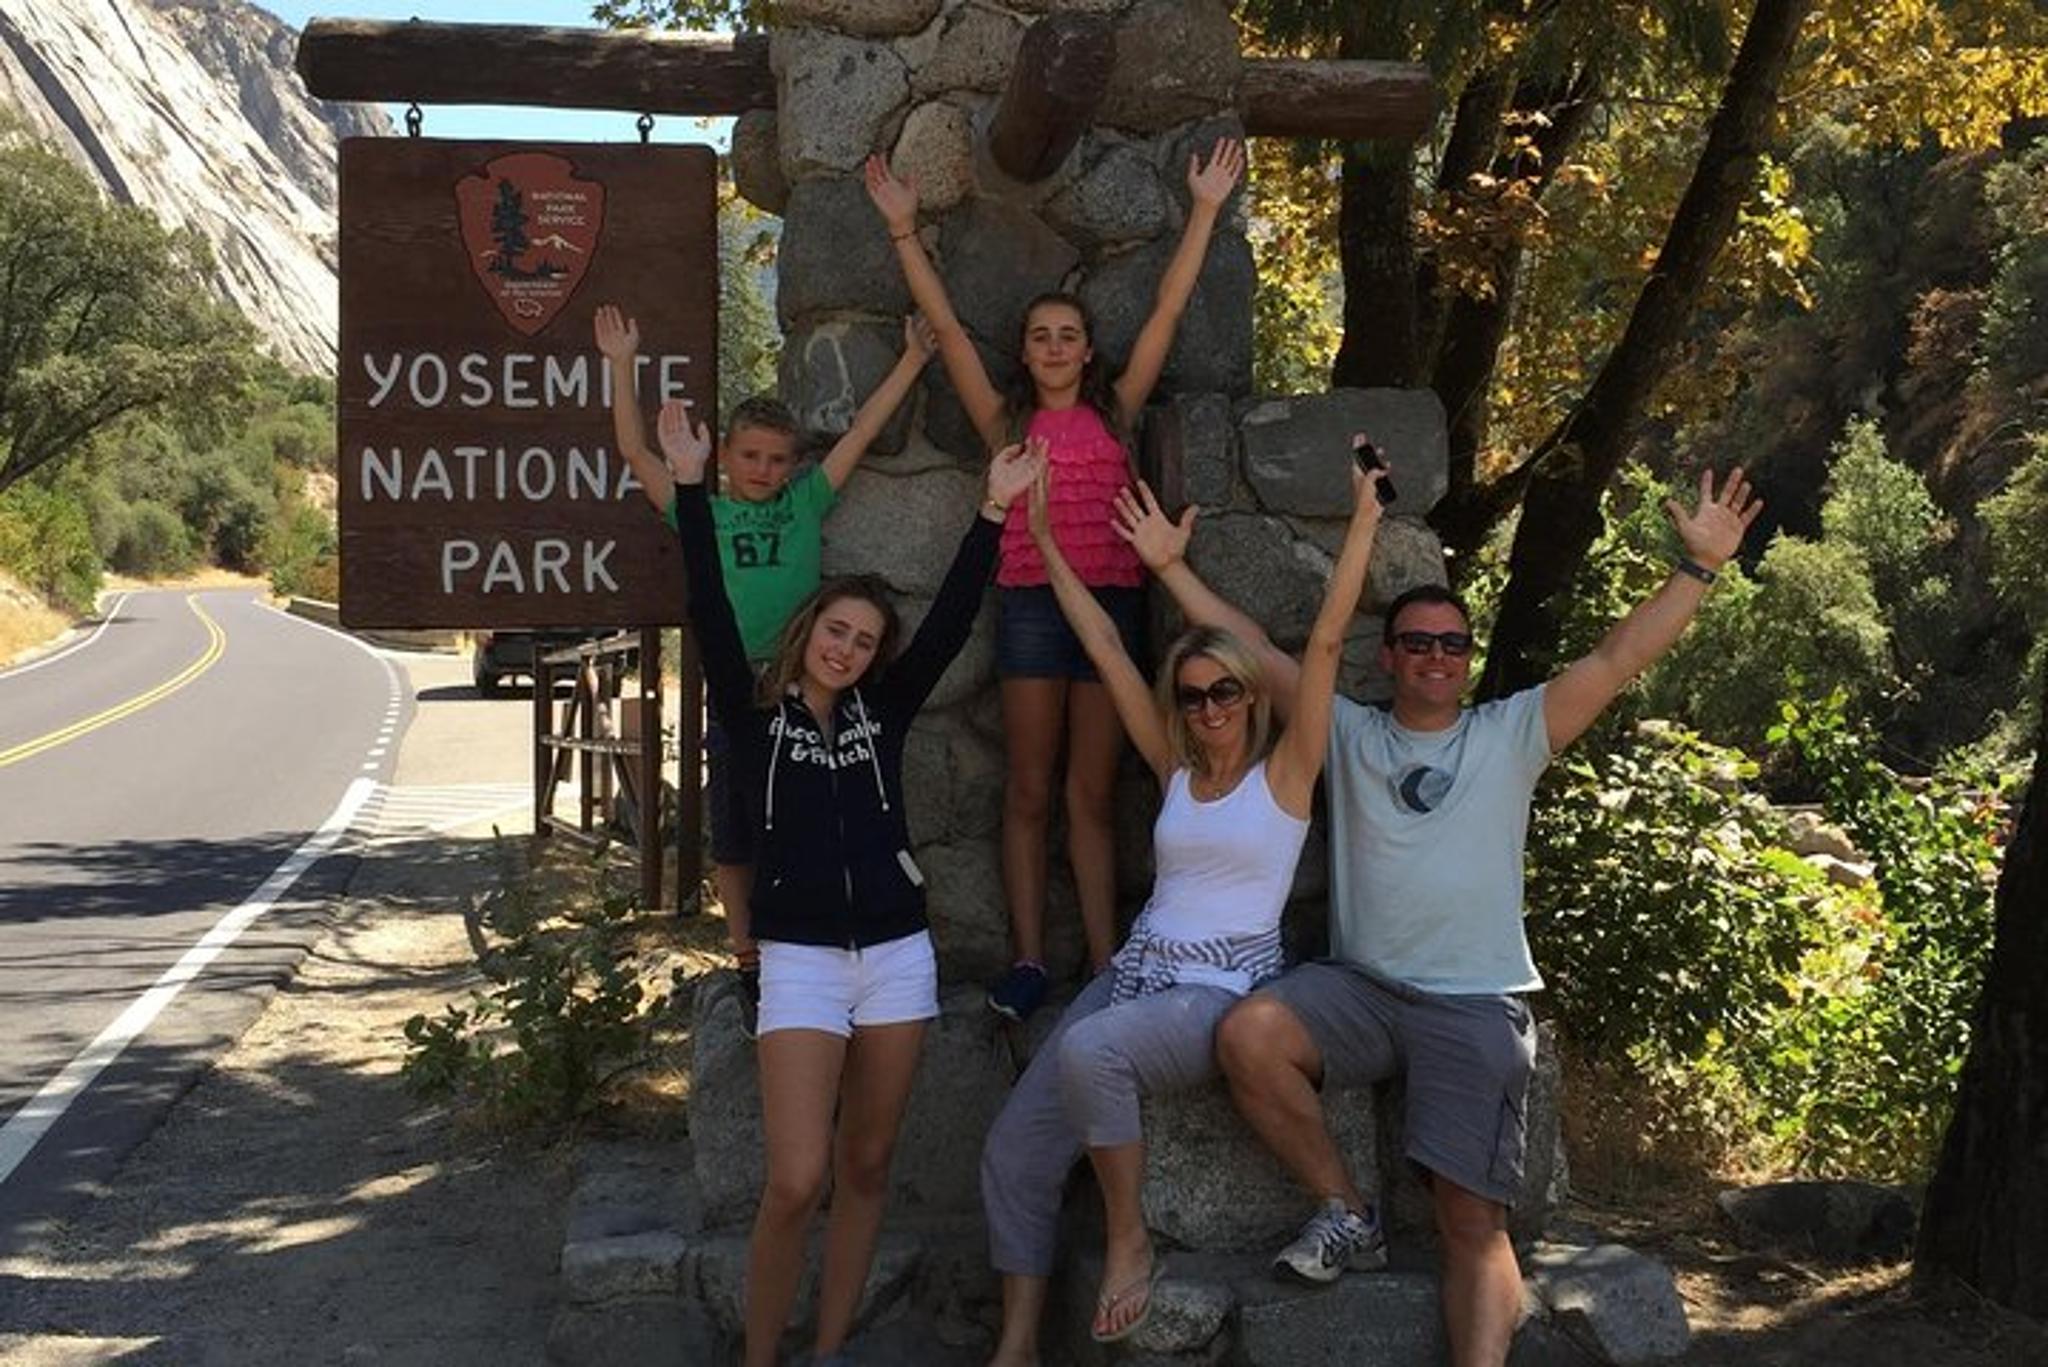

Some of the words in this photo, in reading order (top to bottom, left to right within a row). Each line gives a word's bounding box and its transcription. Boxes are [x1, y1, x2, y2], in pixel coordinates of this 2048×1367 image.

[538, 215, 585, 226] SERVICE
[546, 204, 575, 212] PARK
[361, 446, 646, 502] NATION
[441, 539, 620, 594] PARK
[732, 532, 780, 568] 67
